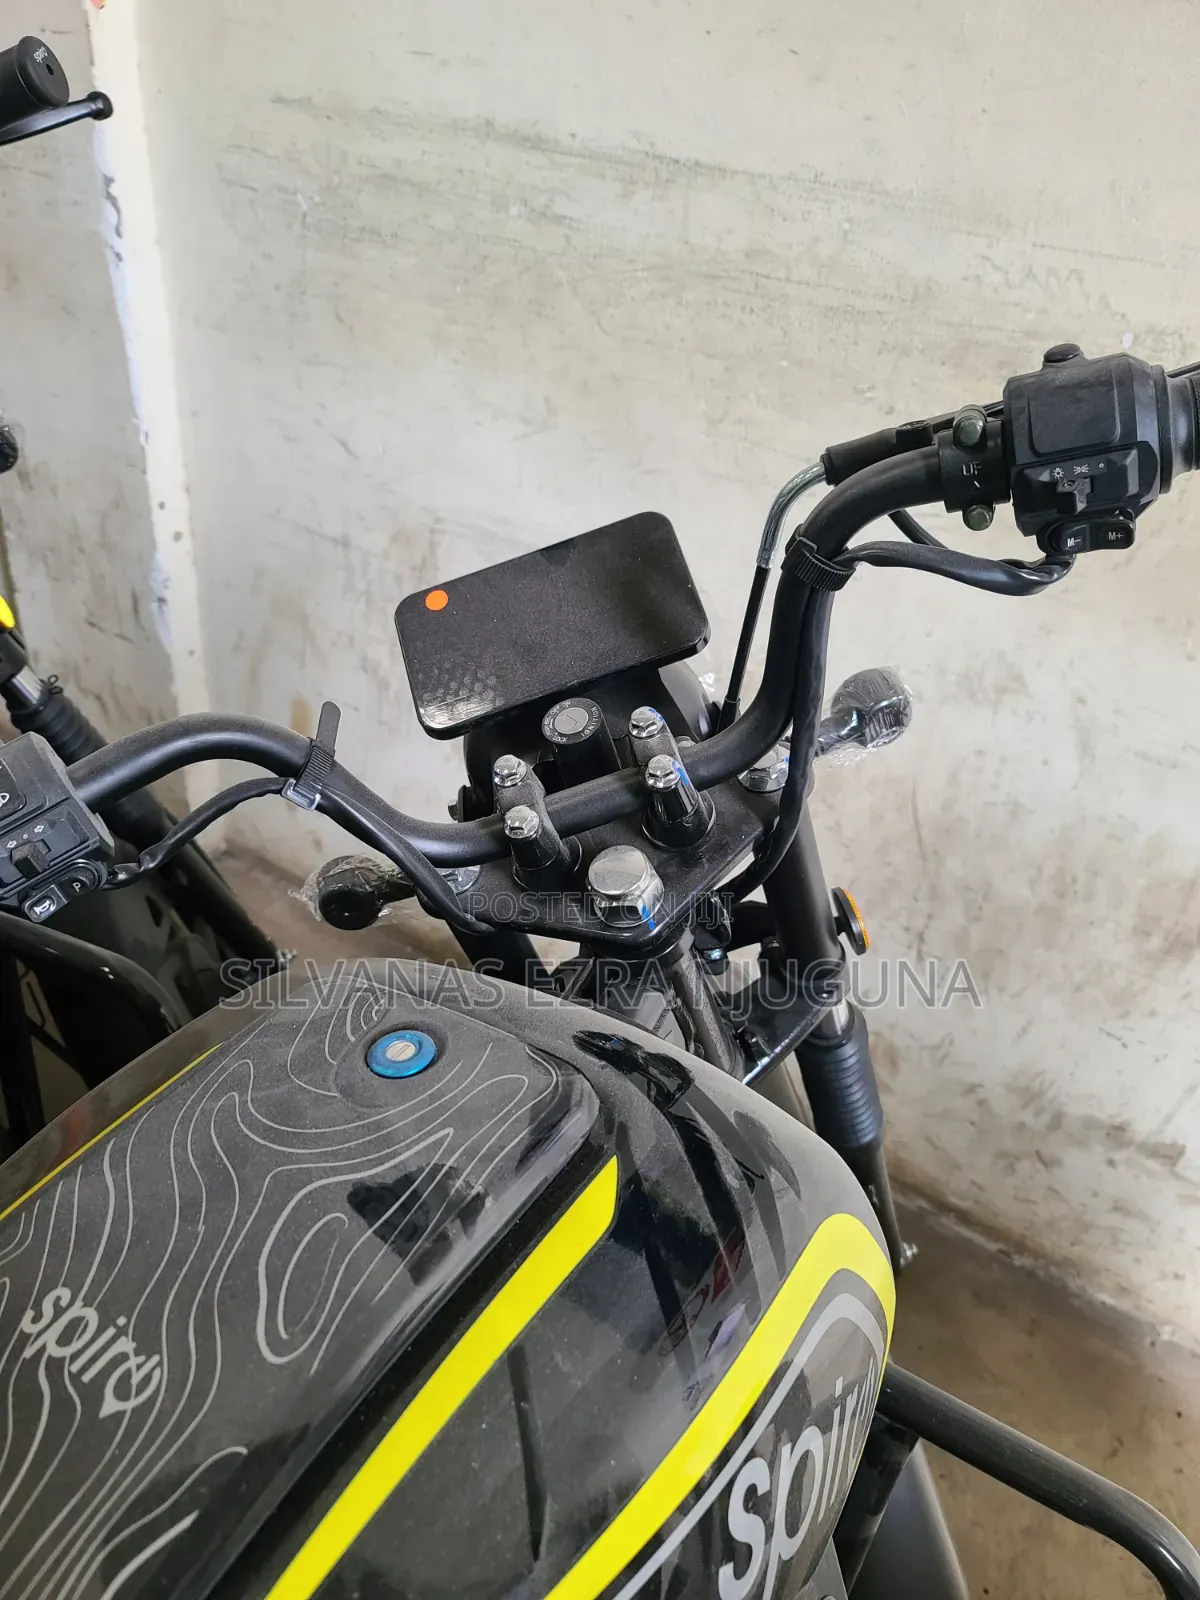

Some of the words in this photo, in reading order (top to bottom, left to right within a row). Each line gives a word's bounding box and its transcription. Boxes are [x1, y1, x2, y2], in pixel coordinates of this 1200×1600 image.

[1108, 531, 1124, 541] M+
[581, 706, 600, 737] IGNITION
[72, 882, 80, 892] P
[21, 1287, 161, 1419] spiro
